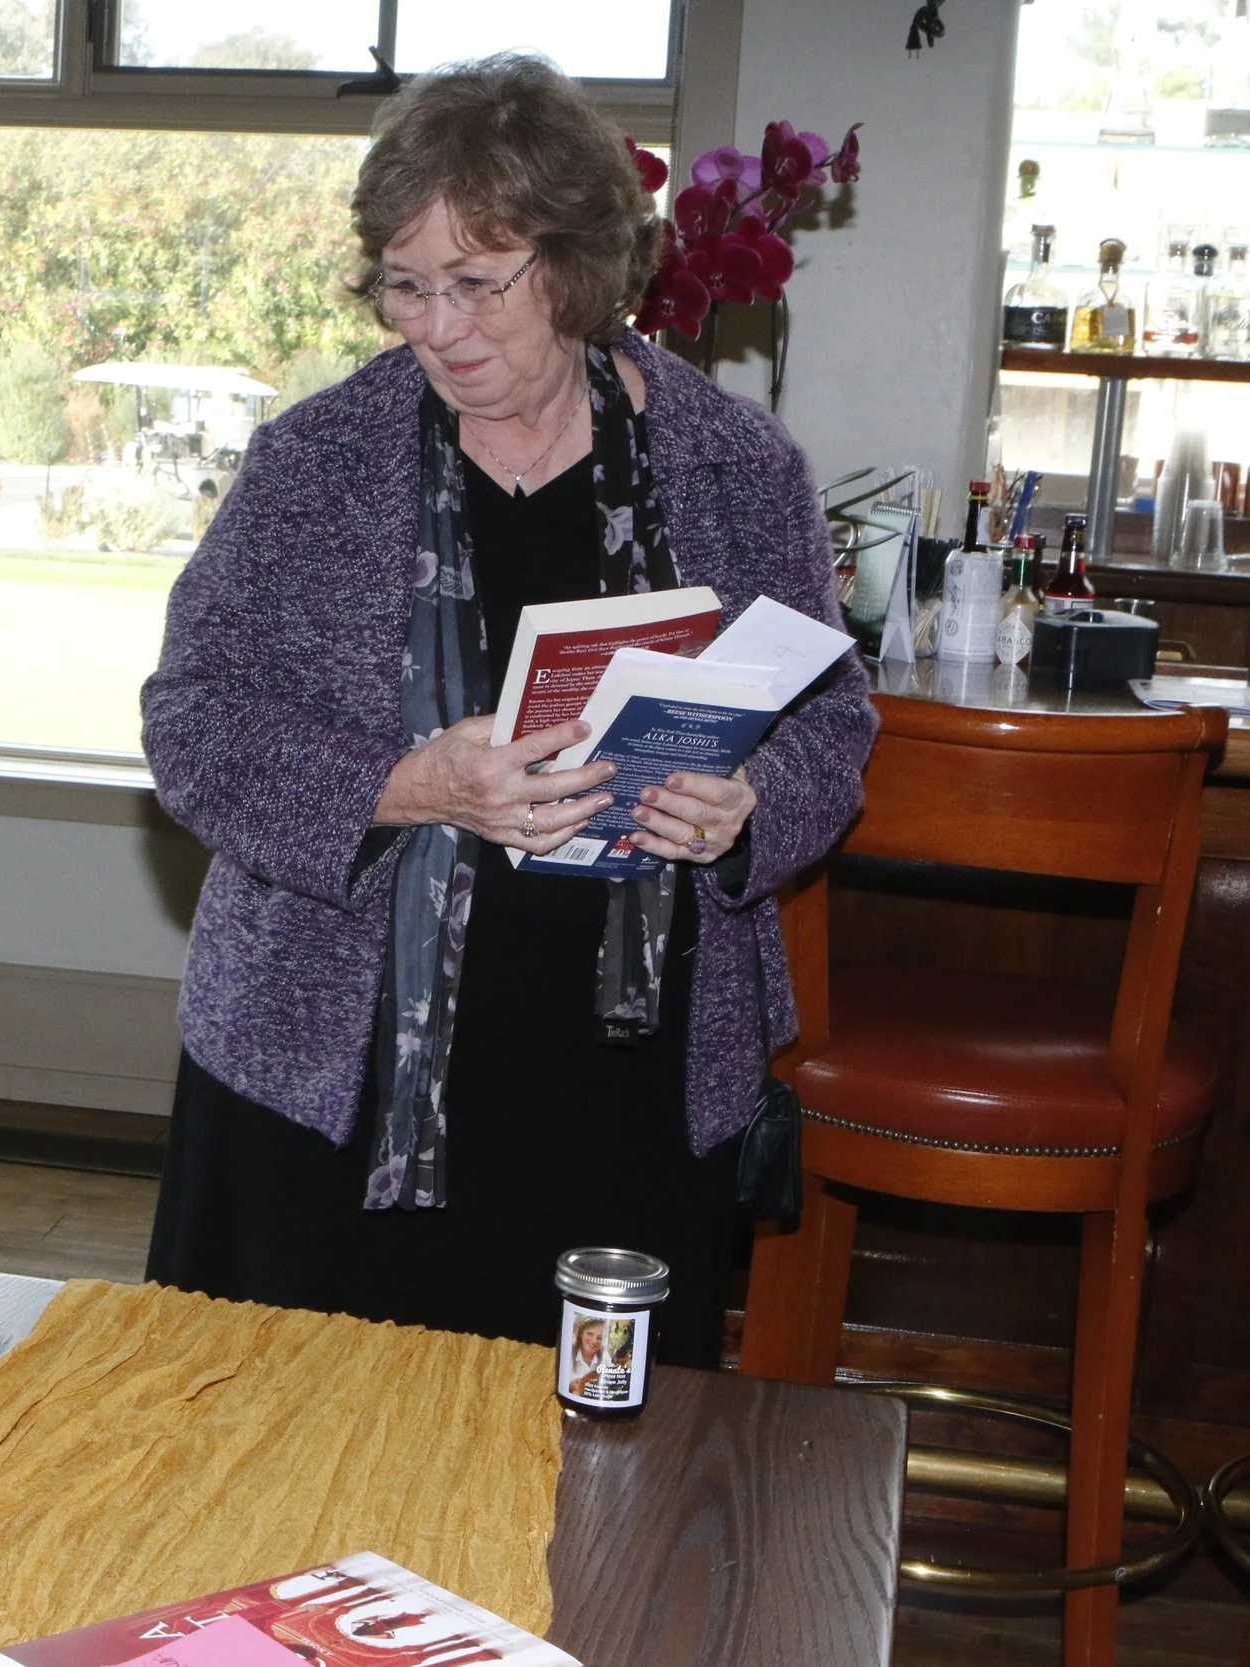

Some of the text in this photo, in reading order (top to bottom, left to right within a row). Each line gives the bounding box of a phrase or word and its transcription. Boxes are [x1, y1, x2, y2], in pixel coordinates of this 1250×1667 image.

[997, 636, 1032, 646] ABASCO
[533, 669, 551, 685] E
[642, 732, 675, 743] ALKA
[596, 1364, 631, 1374] Renate's
